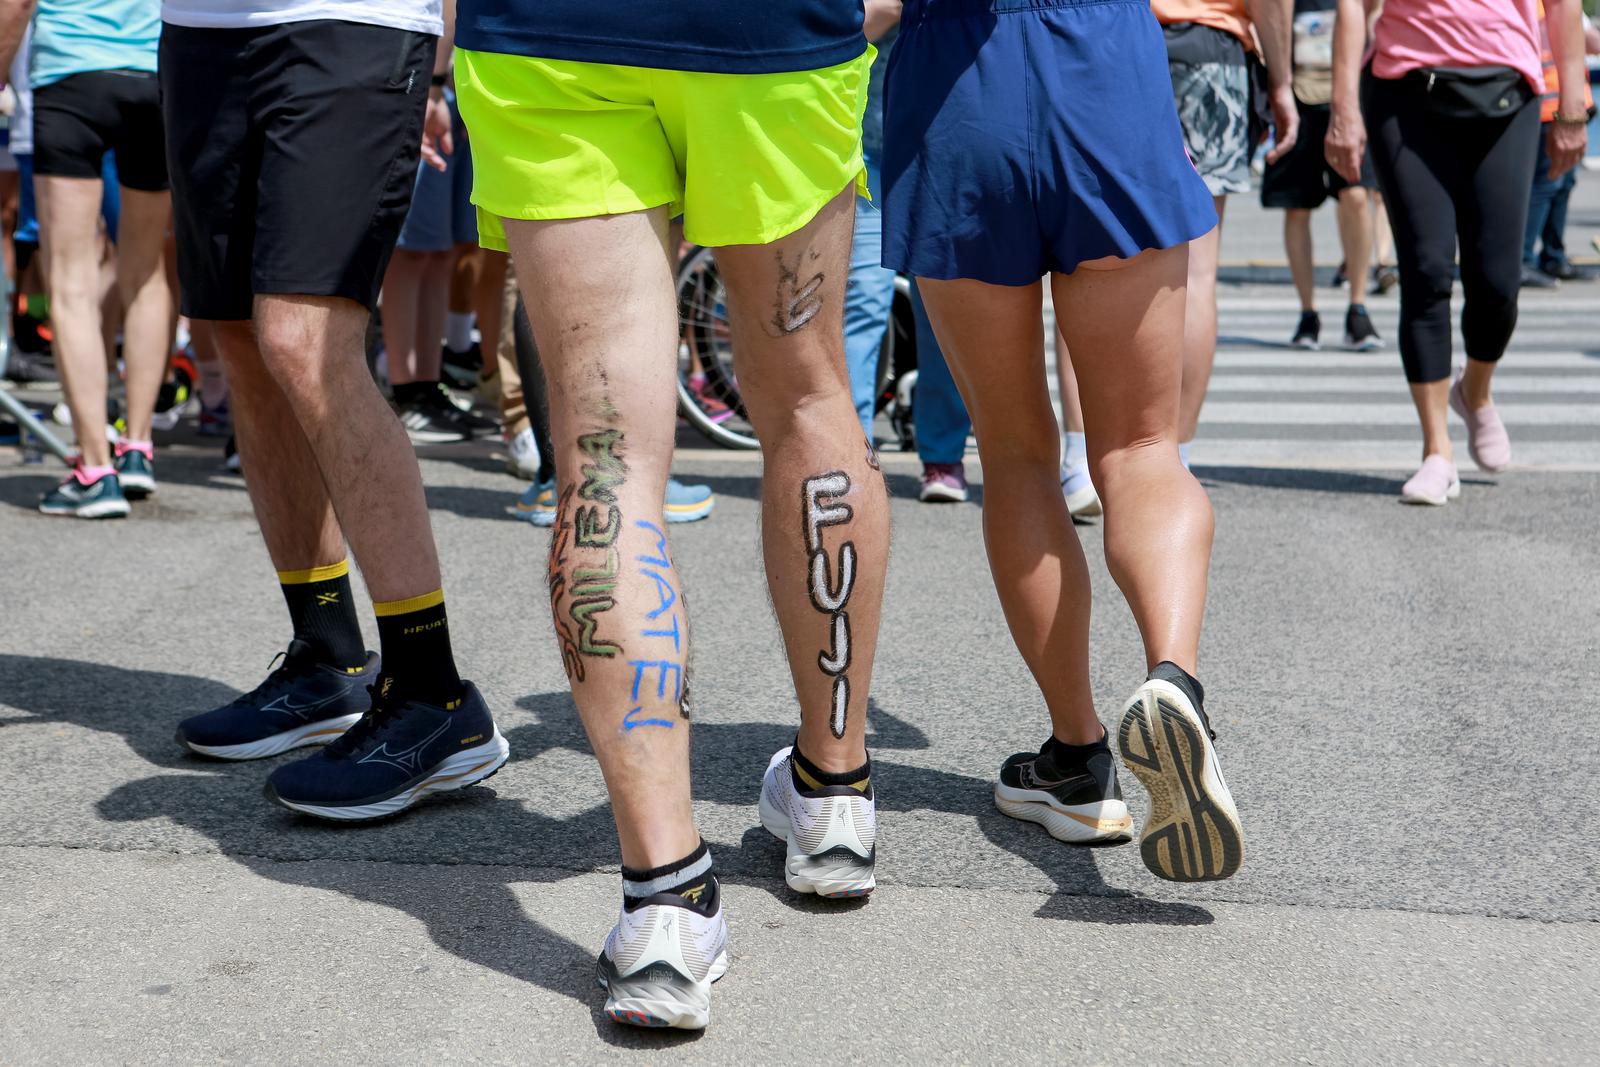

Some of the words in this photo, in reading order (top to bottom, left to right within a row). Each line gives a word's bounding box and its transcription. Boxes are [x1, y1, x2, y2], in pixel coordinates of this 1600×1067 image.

[568, 428, 628, 659] MILENA
[623, 519, 682, 734] MATEJ
[802, 470, 857, 739] FUJI
